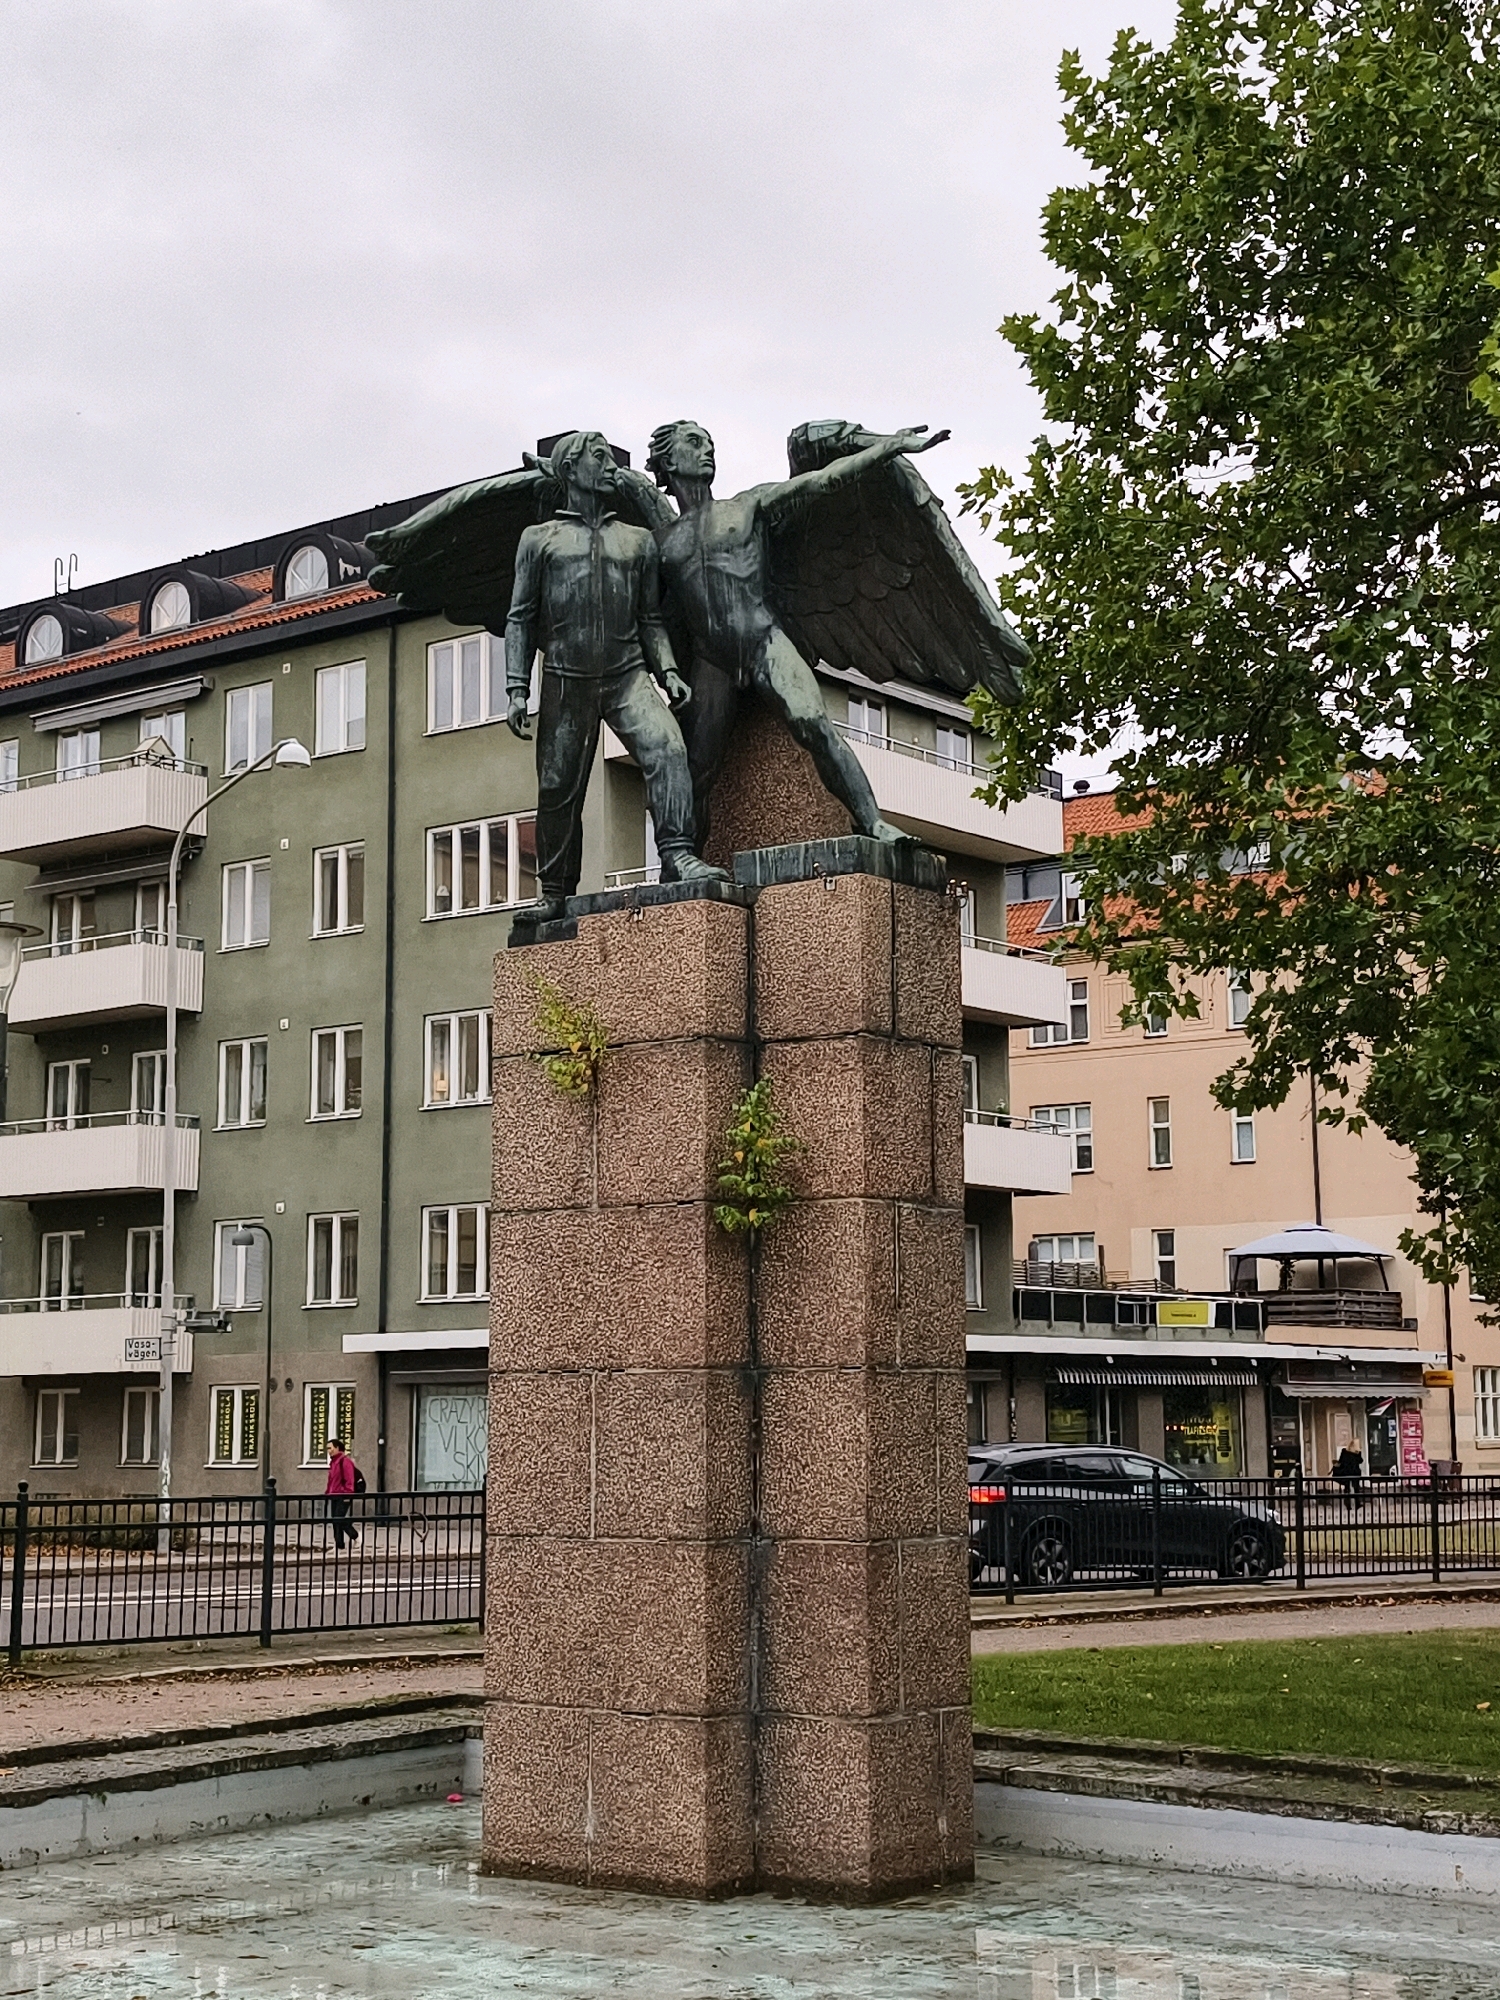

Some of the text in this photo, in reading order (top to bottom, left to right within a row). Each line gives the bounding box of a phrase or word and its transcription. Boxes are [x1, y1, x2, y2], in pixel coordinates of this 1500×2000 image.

[128, 1339, 156, 1349] Vasa-
[128, 1349, 157, 1361] vägen
[428, 1397, 475, 1424] CRAZY
[438, 1424, 457, 1452] VI
